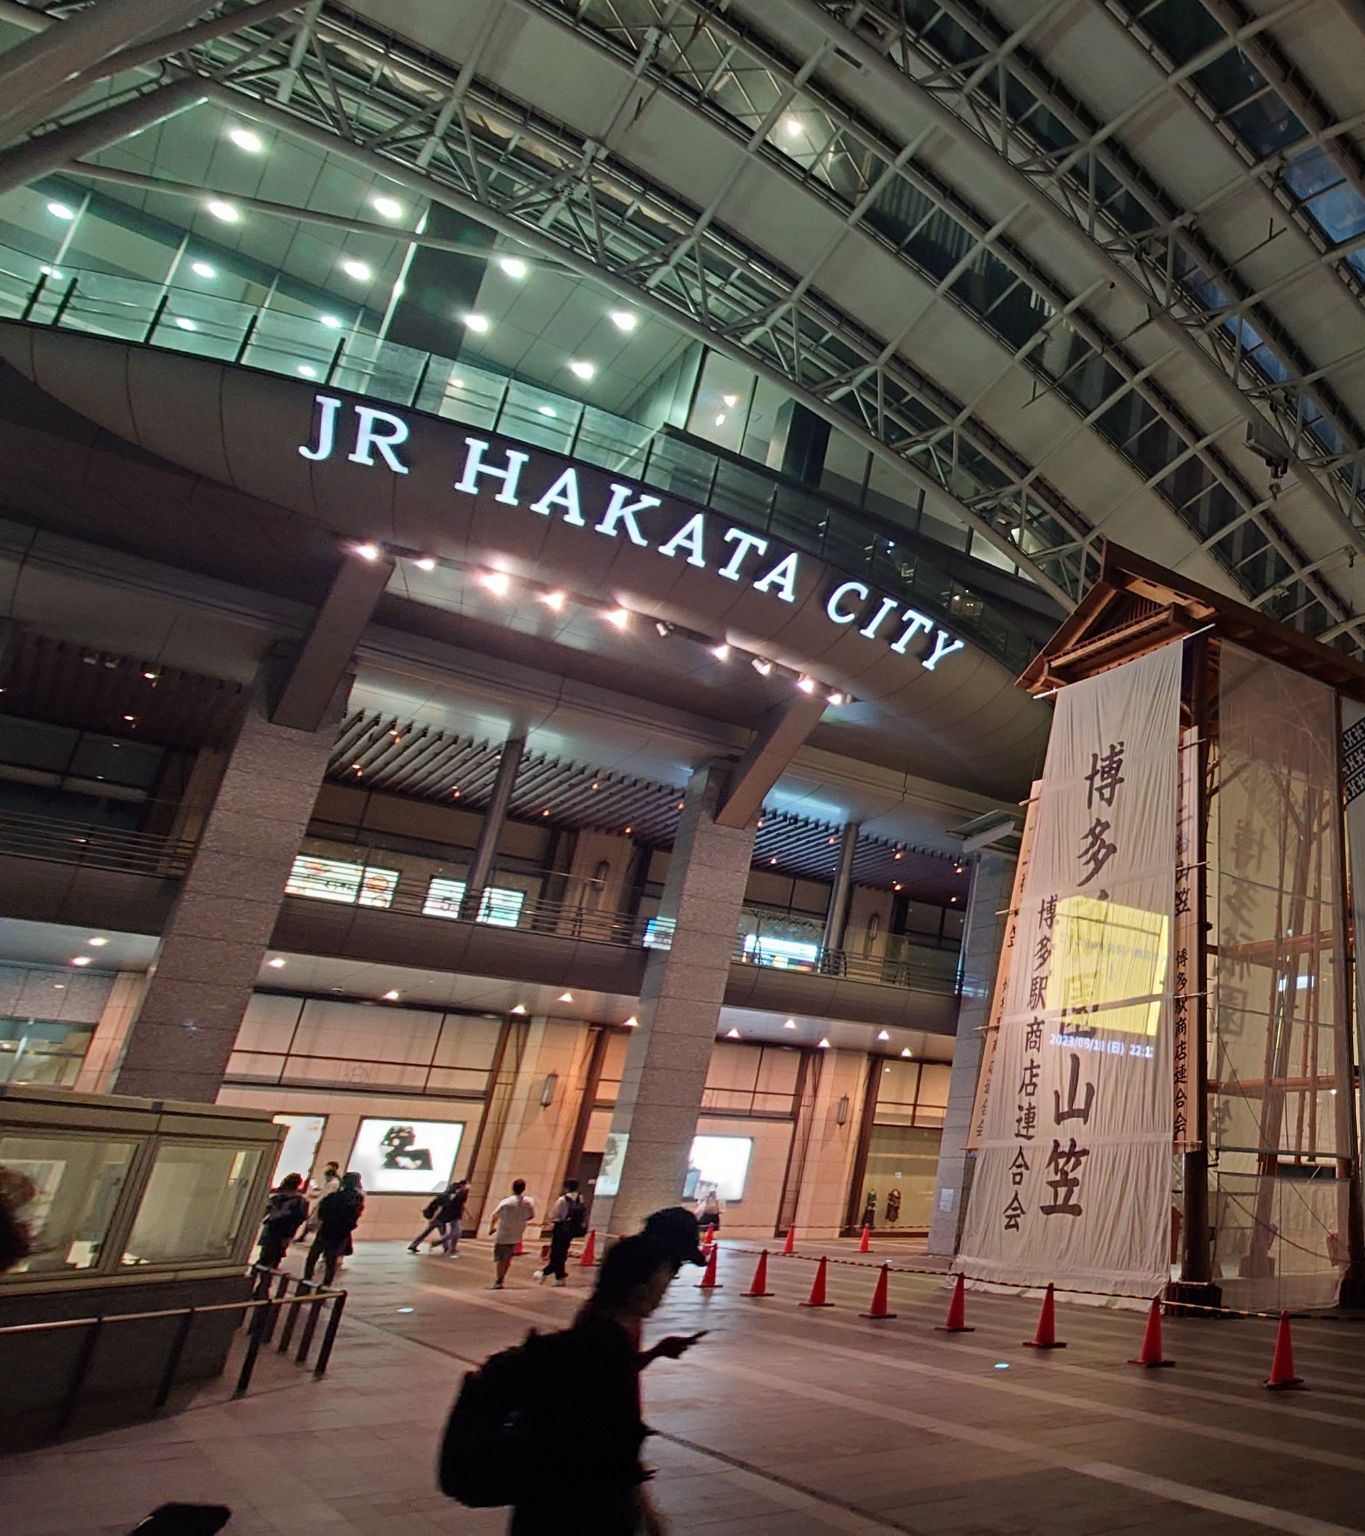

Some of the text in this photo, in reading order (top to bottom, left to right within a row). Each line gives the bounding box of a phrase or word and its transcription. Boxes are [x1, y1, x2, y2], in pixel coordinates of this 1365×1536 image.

[298, 395, 966, 672] JR HAKATA CITY
[1002, 893, 1058, 1233] 博多駅商店連合会
[1040, 740, 1126, 1217] 博多園山笠
